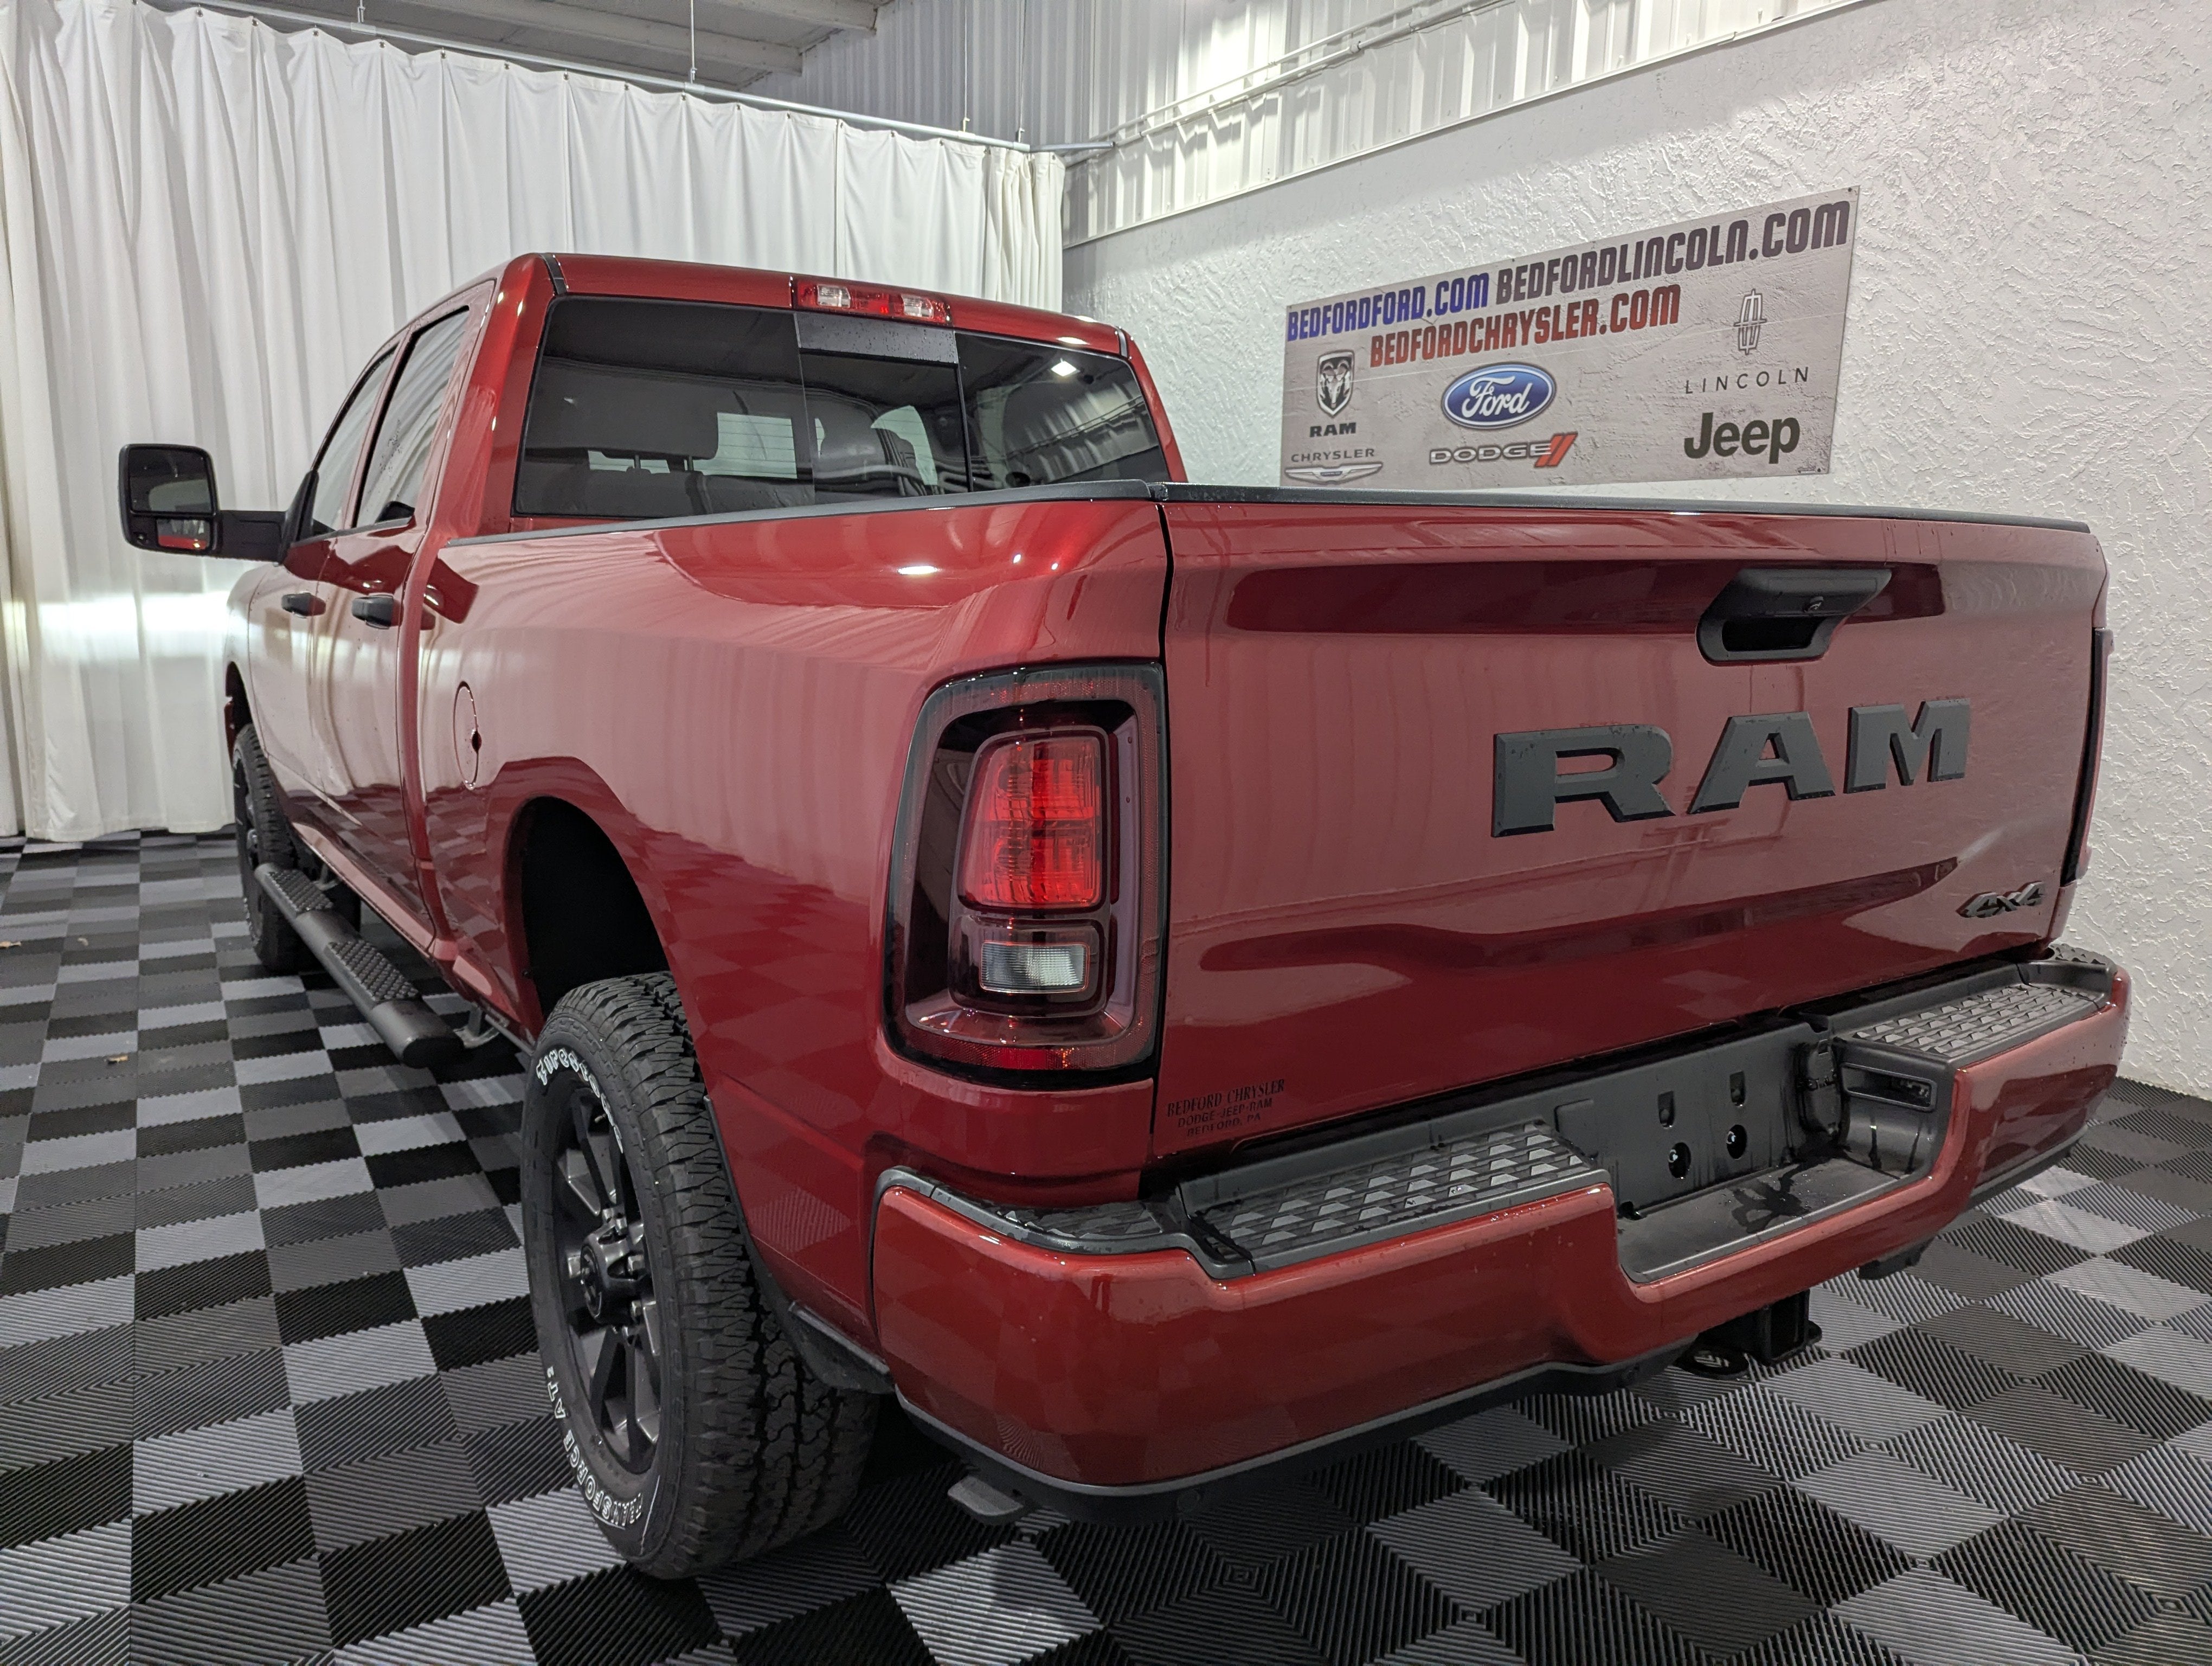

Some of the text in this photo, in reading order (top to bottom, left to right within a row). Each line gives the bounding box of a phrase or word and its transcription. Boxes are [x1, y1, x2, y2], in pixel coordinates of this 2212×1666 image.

[1287, 200, 1850, 342] BEDFORDFORD.COM BEDFORDLINCOLN.COM
[1369, 284, 1681, 368] BEDFORDCHRYSLER.COM
[1463, 376, 1531, 419] Ford
[1684, 366, 1809, 394] LINCOLN
[1310, 422, 1356, 437] RAM
[1684, 412, 1800, 464] Jeep
[1291, 448, 1374, 462] CHRYSLER
[1429, 443, 1552, 465] DODGE
[1491, 697, 1970, 838] RAM
[1167, 1079, 1284, 1117] BEDFORD CHRYSLER
[1247, 1113, 1261, 1123] PA
